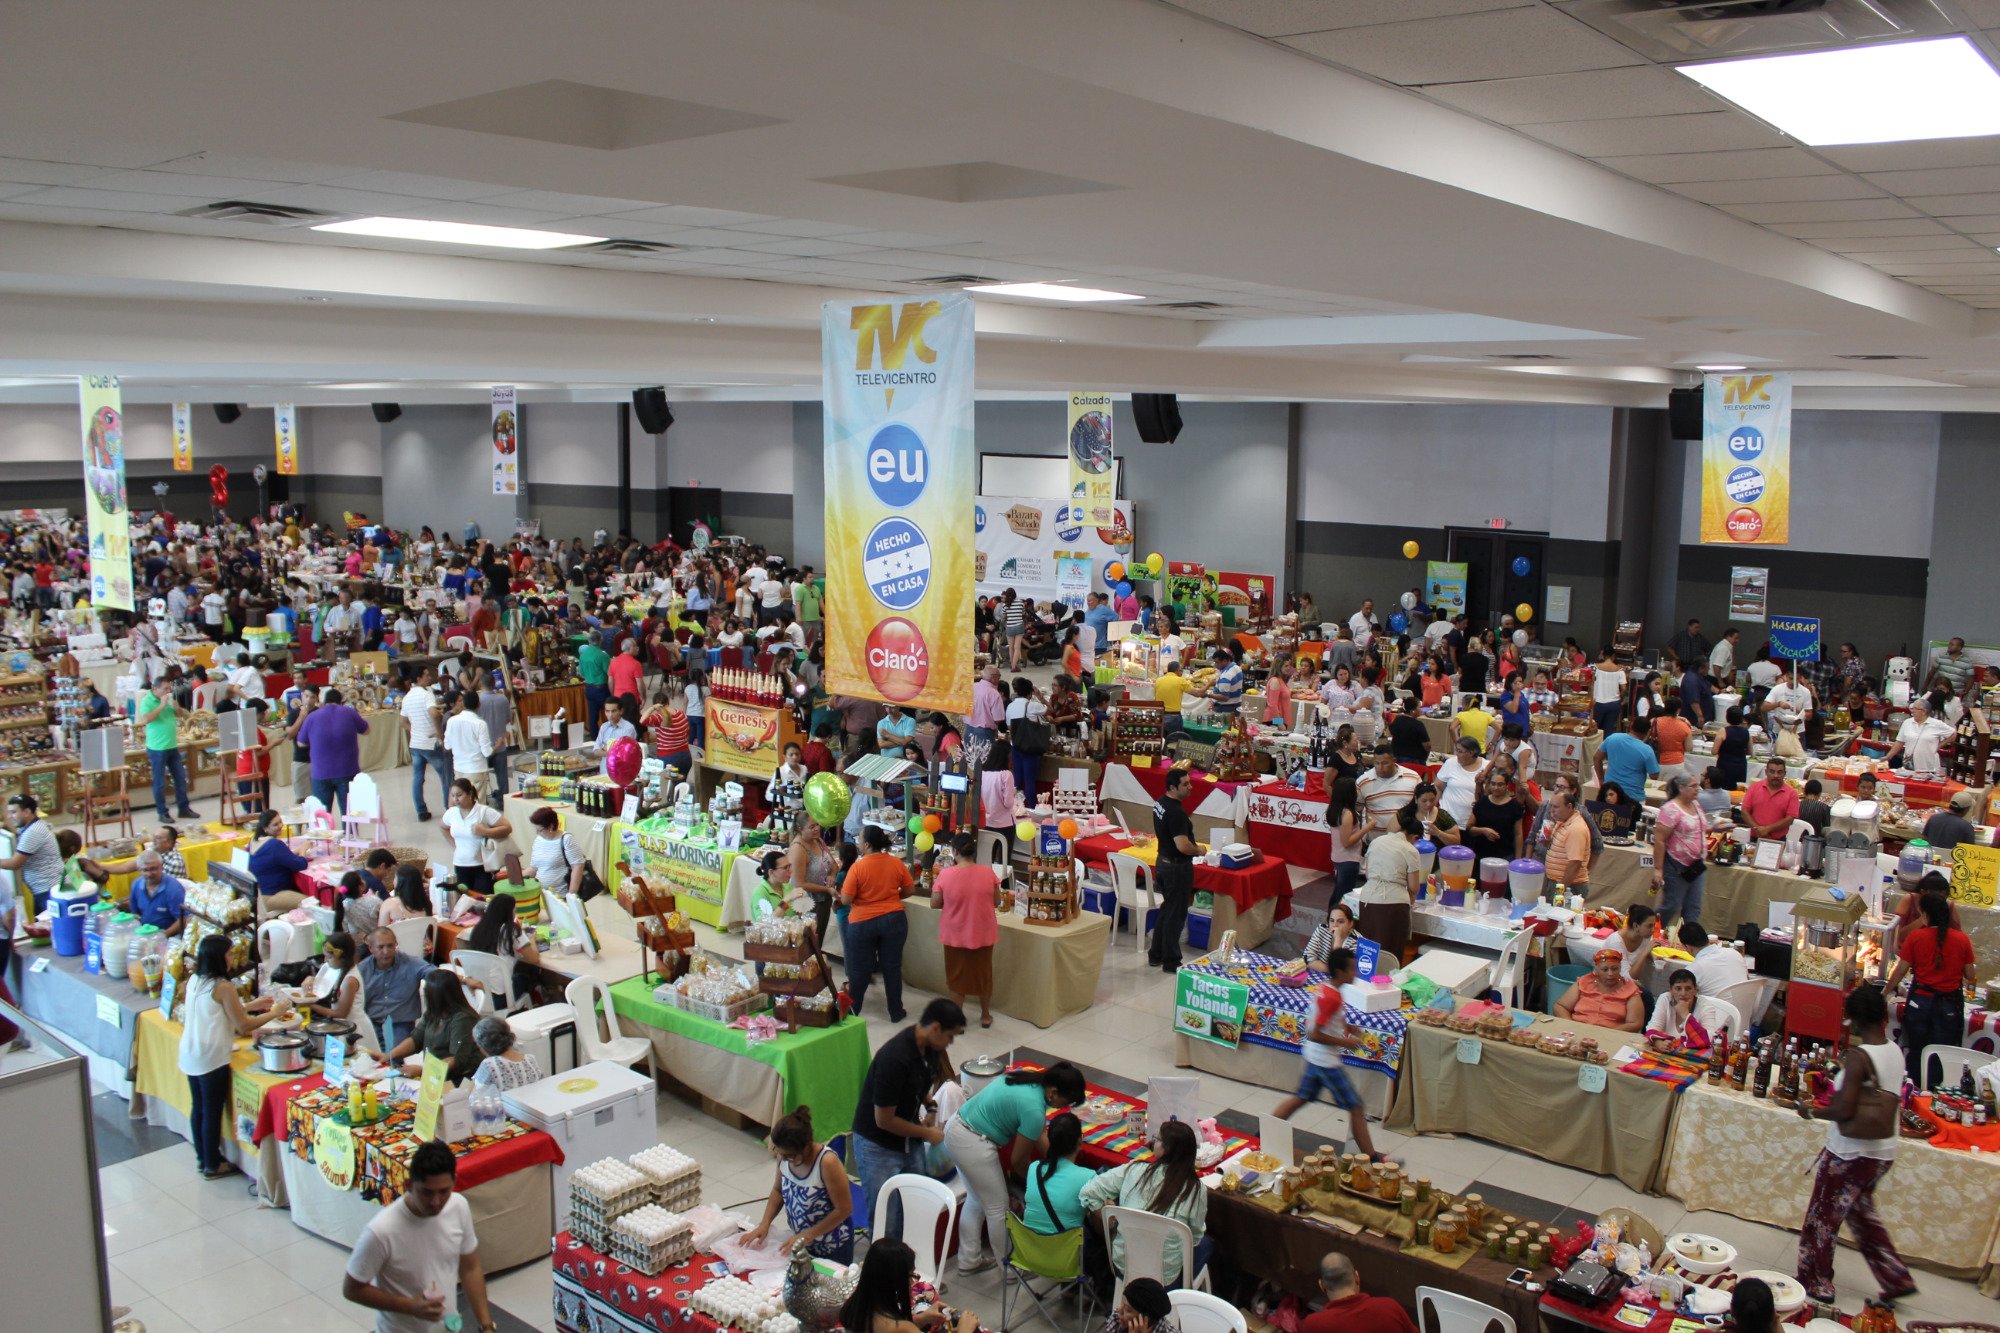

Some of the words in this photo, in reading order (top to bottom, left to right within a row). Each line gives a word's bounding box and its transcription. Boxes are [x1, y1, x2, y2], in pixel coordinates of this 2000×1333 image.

[850, 301, 942, 370] TVC
[856, 372, 937, 385] TELEVICENTRO
[1721, 375, 1776, 404] TVC
[1073, 396, 1111, 406] Calzado
[1730, 435, 1762, 451] eu
[870, 448, 924, 483] eu
[1732, 470, 1753, 481] HECHO
[1736, 492, 1745, 500] EN
[1744, 488, 1761, 499] CASA
[976, 513, 985, 526] u
[1011, 509, 1034, 519] Bazar
[1073, 511, 1084, 519] eu
[1491, 518, 1505, 528] EXIT
[1728, 520, 1756, 530] Claro
[1061, 532, 1069, 540] EN
[1069, 528, 1081, 538] CASA
[875, 531, 911, 553] HECHO
[881, 583, 897, 598] EN
[897, 575, 924, 593] CASA
[1771, 619, 1818, 634] MASARAP
[1769, 633, 1821, 658] DELICACIES
[869, 646, 920, 672] Claro
[719, 707, 769, 730] Genesis
[638, 833, 668, 854] MAP
[668, 841, 722, 871] MORINGA
[1642, 857, 1654, 866] 178
[1192, 973, 1231, 1000] Tacos
[1185, 989, 1238, 1020] Yolanda
